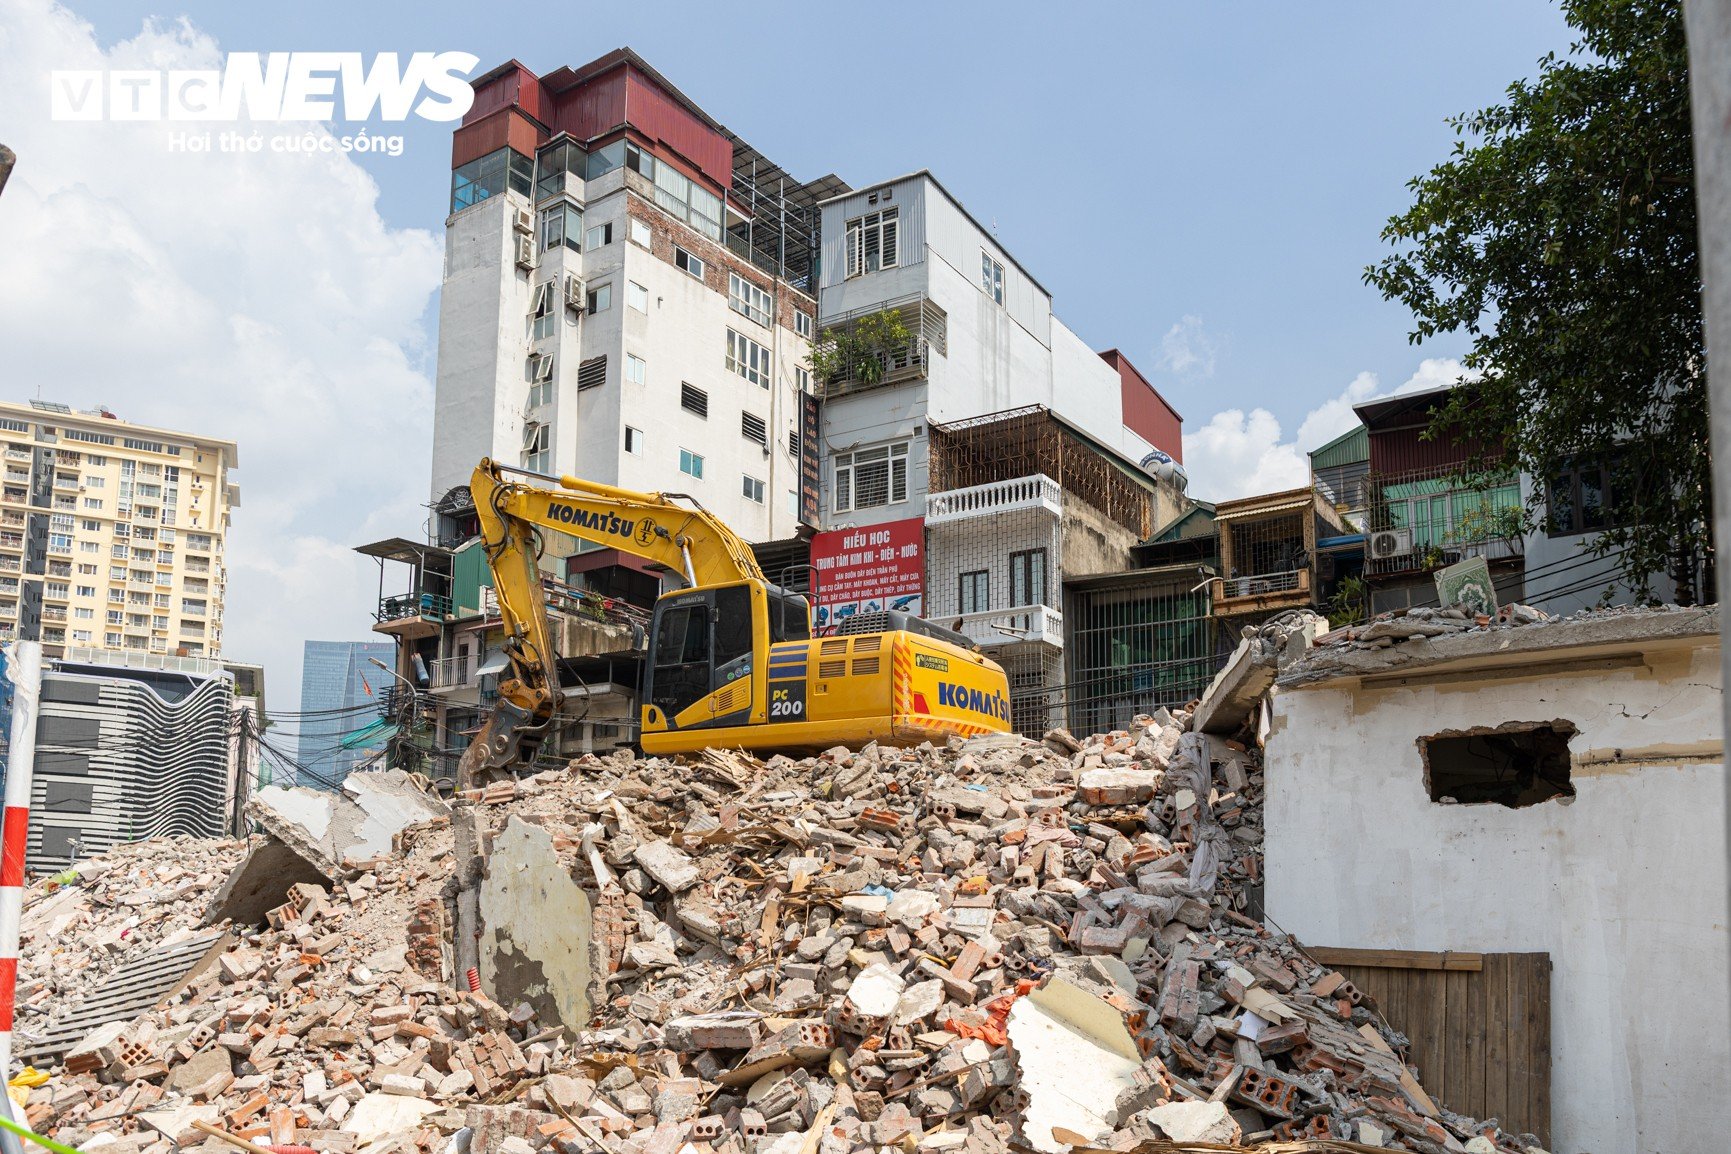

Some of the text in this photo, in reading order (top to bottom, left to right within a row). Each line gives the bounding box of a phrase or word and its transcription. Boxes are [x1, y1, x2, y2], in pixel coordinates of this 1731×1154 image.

[547, 502, 634, 538] KOMATSU
[844, 530, 890, 549] HIẾU HỌC
[772, 689, 788, 701] PC
[771, 700, 802, 716] 200
